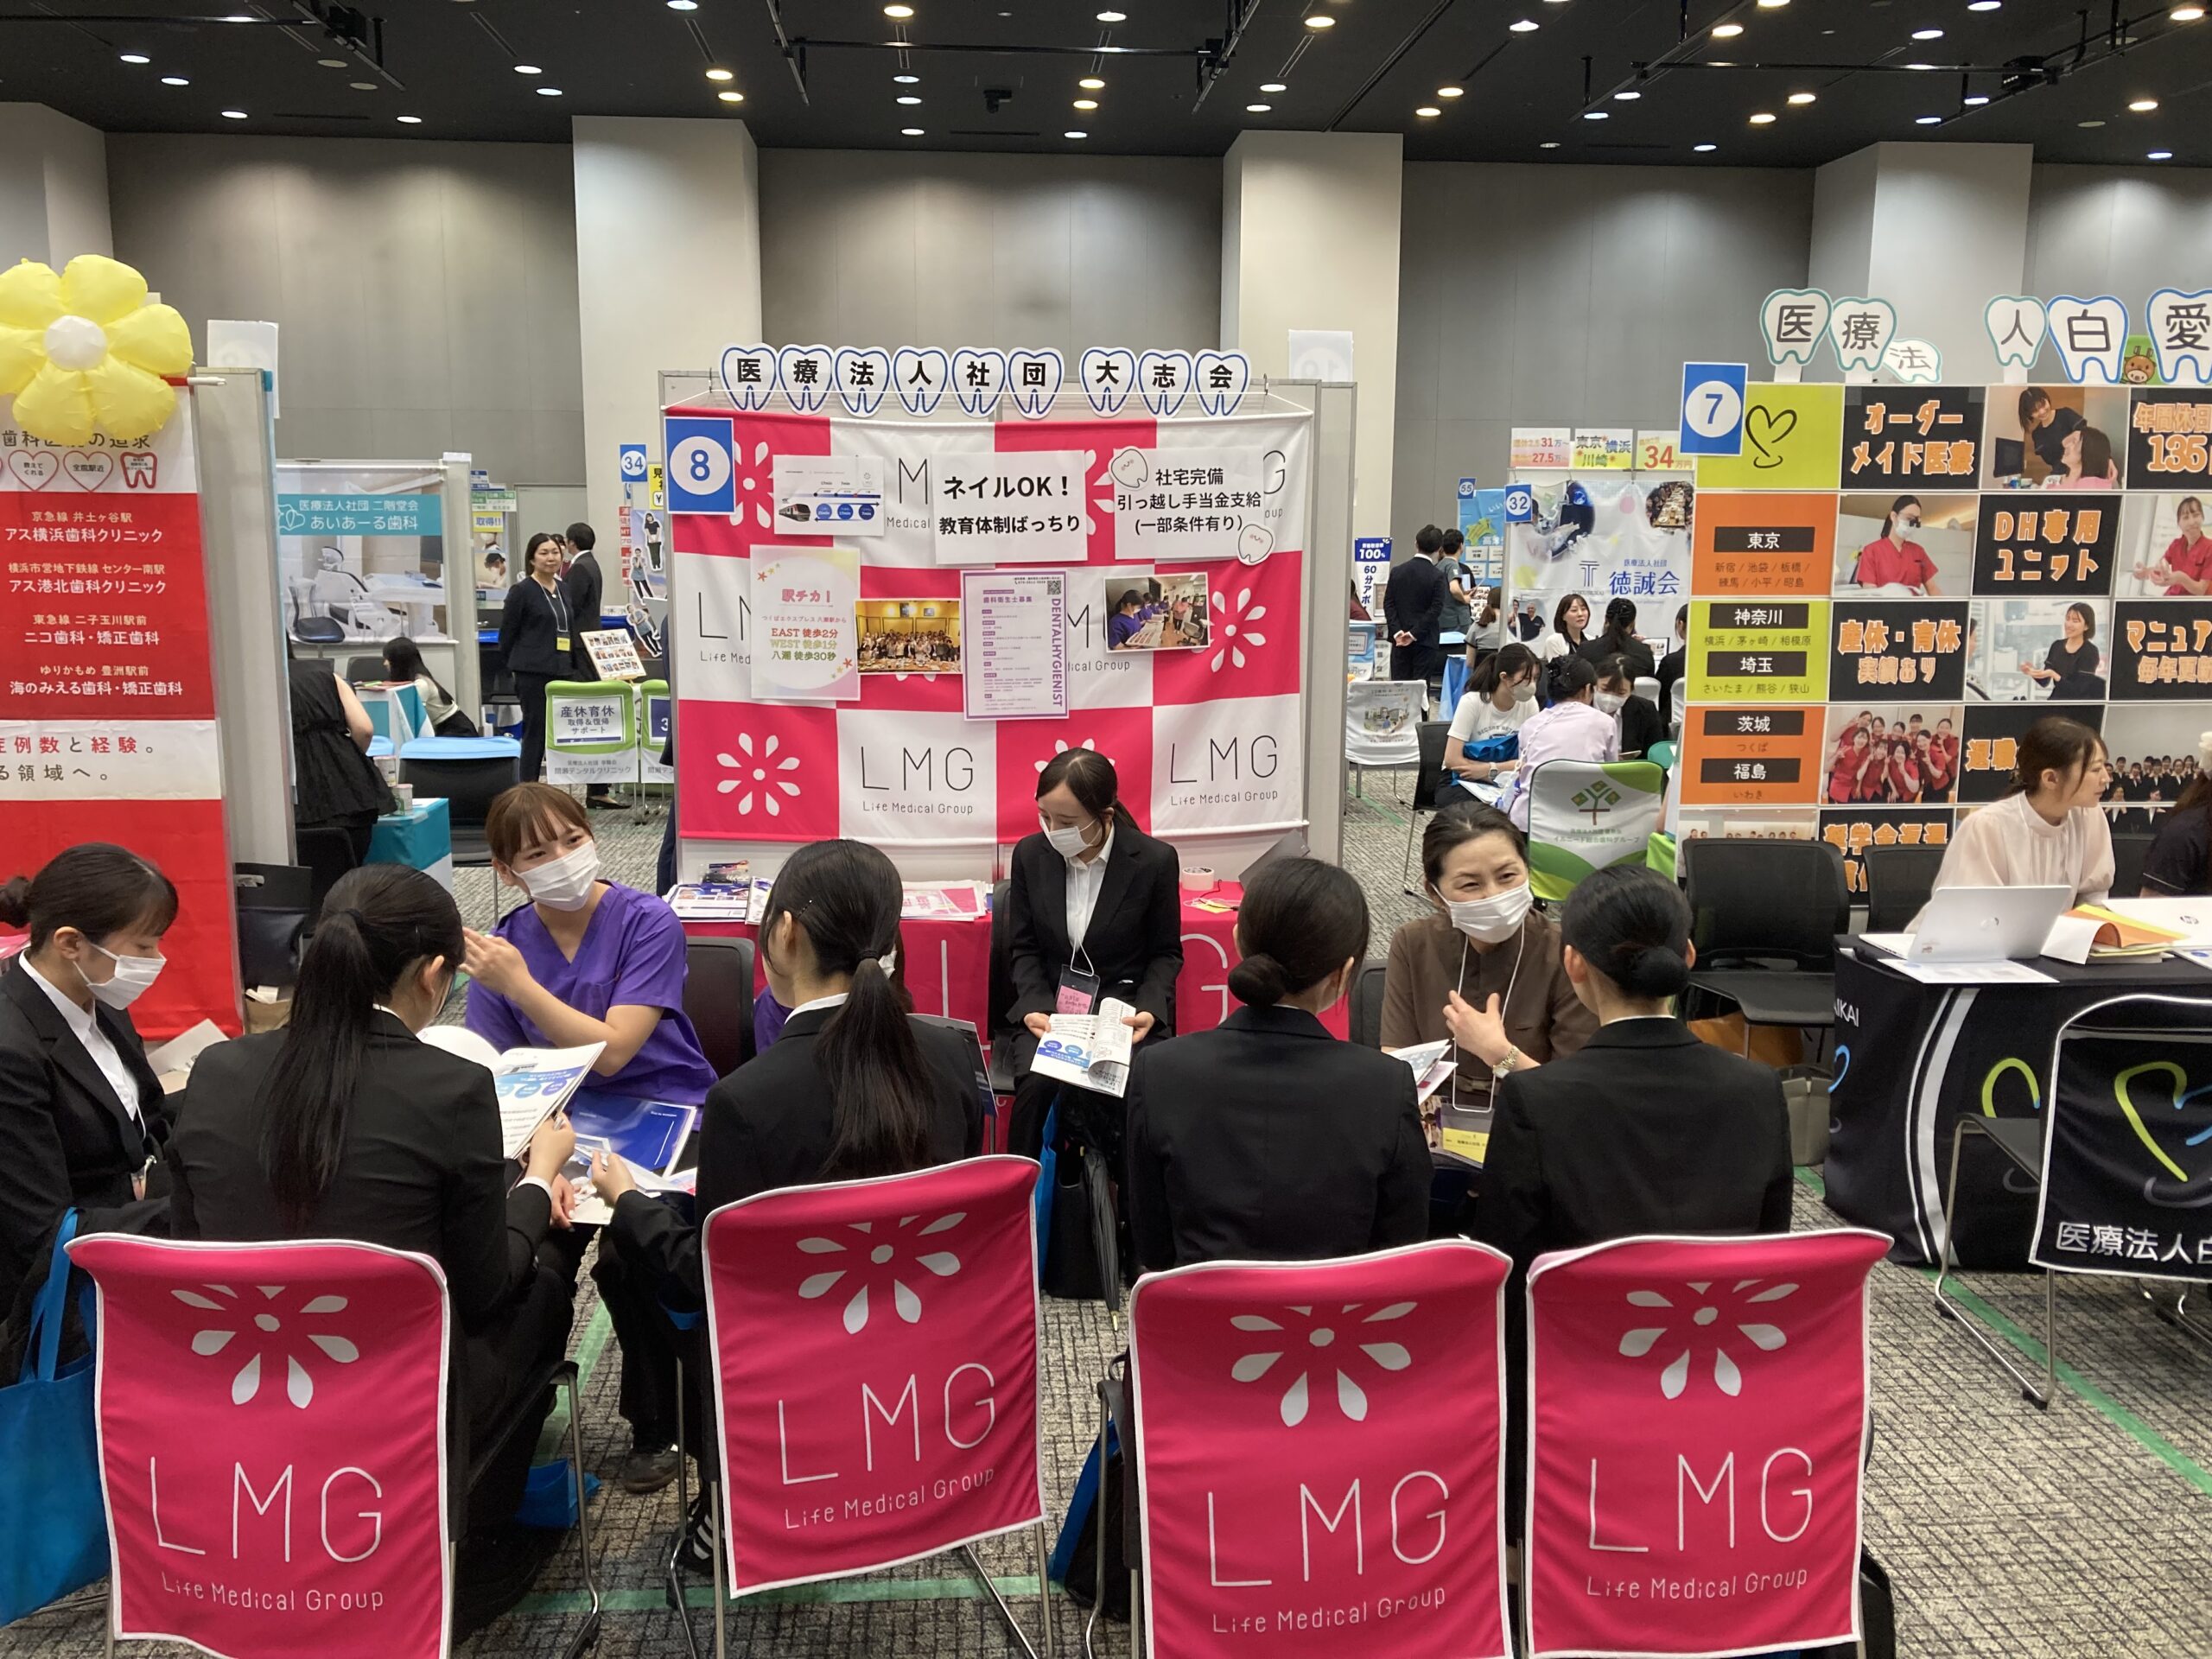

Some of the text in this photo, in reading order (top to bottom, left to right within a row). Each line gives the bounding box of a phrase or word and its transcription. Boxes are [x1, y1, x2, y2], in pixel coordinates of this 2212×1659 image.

[737, 358, 1233, 390] 医療法人社団 大志会
[1705, 393, 1723, 424] 7
[1864, 400, 1964, 435] オーダー
[1576, 435, 1602, 448] 東京
[1605, 440, 1631, 454] 横浜
[624, 456, 644, 470] 34
[690, 449, 709, 481] 8
[1582, 454, 1608, 467] 川崎
[1851, 440, 1975, 475] メイド医療
[1155, 467, 1224, 486] 社宅完備
[943, 475, 1071, 500] ネイルOK！
[299, 499, 419, 512] 医療法人社団 二階堂会
[1117, 491, 1262, 512] 引っ越し手当金支給
[1510, 497, 1528, 510] 32
[32, 512, 68, 523] 京急線
[310, 516, 418, 531] あいあーる歯科
[887, 516, 931, 530] Medical
[938, 514, 1081, 536] 教育体制ばっちり
[1994, 509, 2102, 544] DH専用
[5, 528, 163, 543] アス横浜歯科クリニック
[1747, 531, 1781, 550] 東京
[9, 563, 166, 575] 横浜市営地下鉄線 センター南駅
[1993, 549, 2100, 581] ユニット
[9, 579, 167, 594] アス港北歯科クリニック
[1609, 570, 1681, 595] 徳誠会
[33, 614, 147, 626] 東急線 二子玉川駅前
[1734, 608, 1783, 626] 神奈川
[24, 631, 160, 645] ニコ歯科・矯正歯科
[772, 628, 838, 639] EAST 徒歩2分
[1838, 619, 1962, 655] 産休・育休
[770, 639, 800, 649] WEST
[701, 650, 726, 663] Life
[794, 651, 836, 662] 徒歩30秒
[40, 665, 149, 677] ゆりかもめ 豊洲駅前
[1095, 660, 1130, 671] Group
[1740, 657, 1773, 673] 埼玉
[1858, 656, 1937, 685] 実績あり
[10, 681, 183, 696] 海のみえる歯科・矯正歯科
[561, 705, 615, 718] 産休育休
[571, 726, 606, 734] サポート
[1738, 715, 1770, 733] 茨城
[1737, 742, 1769, 753] つくば
[1170, 734, 1278, 784] LMG
[861, 746, 974, 791] LMG
[1734, 763, 1767, 780] 福島
[1171, 790, 1279, 806] Life Medical Group
[1733, 790, 1763, 800] いわき
[863, 800, 974, 816] Life Medical Group
[779, 1363, 995, 1485] LMG
[785, 1468, 995, 1530] Life Medical Group
[1588, 1447, 1813, 1552] LMG
[150, 1456, 382, 1562] LMG
[1208, 1471, 1449, 1586] LMG
[162, 1572, 384, 1611] Life Medical Group
[1586, 1568, 1808, 1599] Life Medical Group
[1212, 1586, 1446, 1633] Life Medical Group
